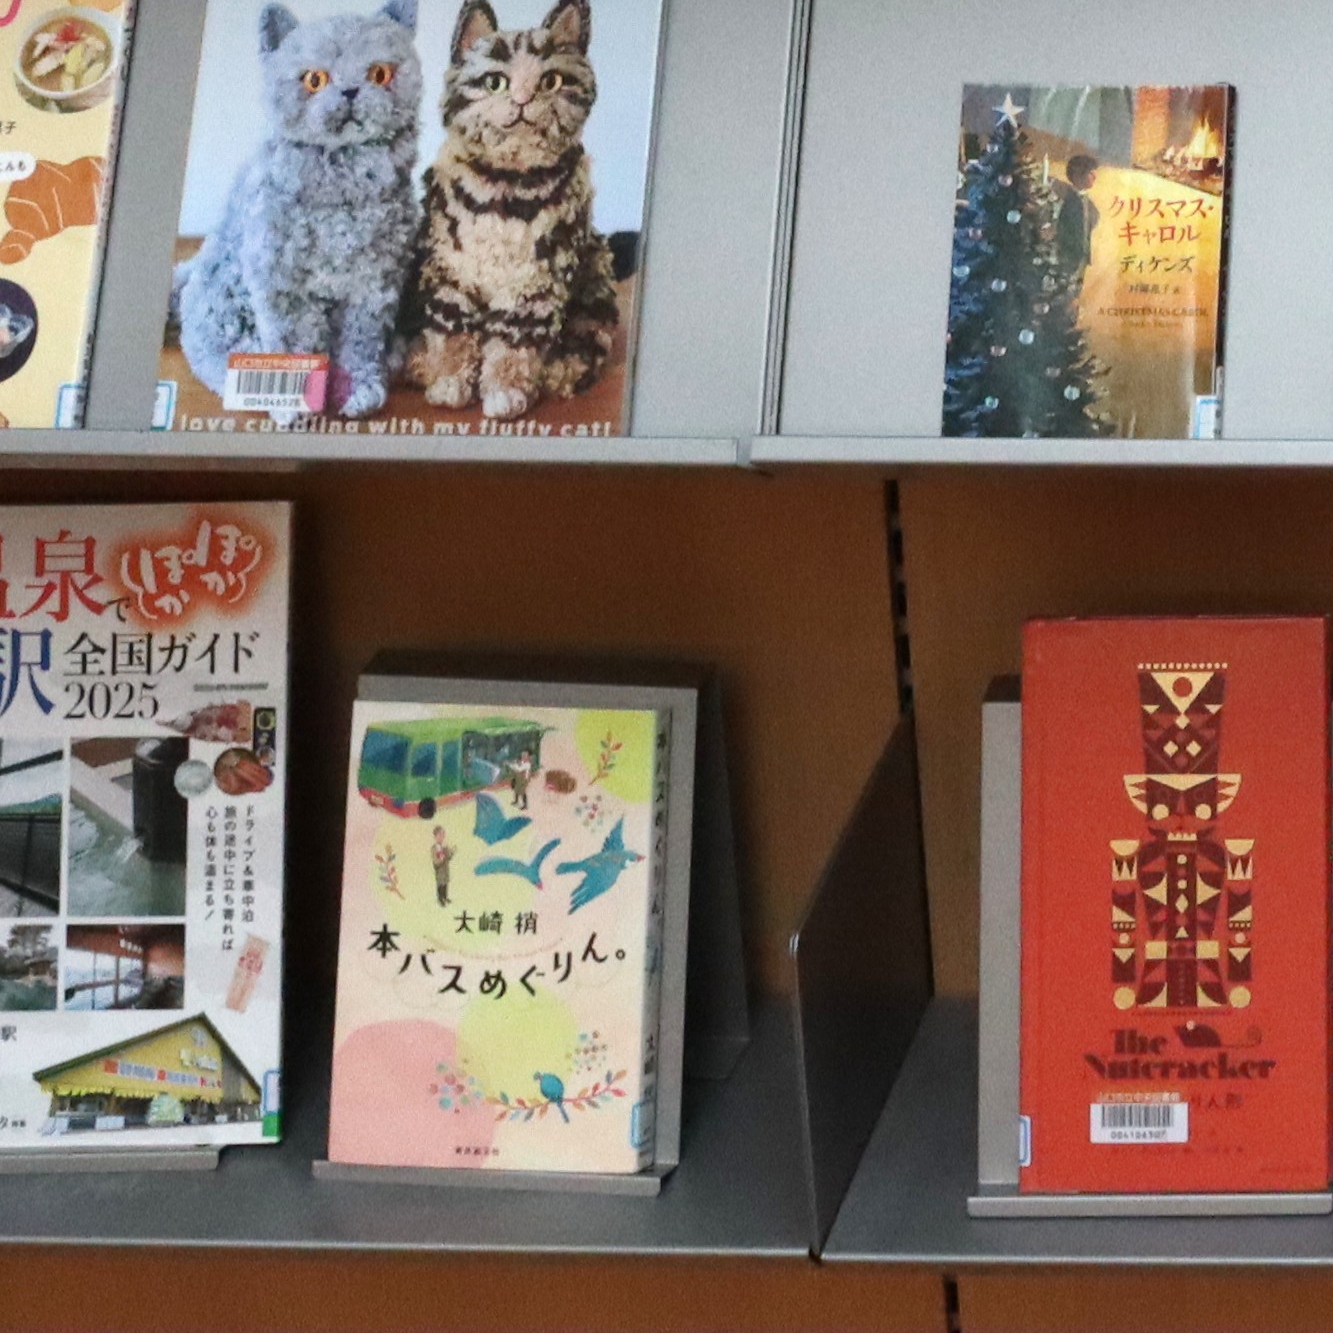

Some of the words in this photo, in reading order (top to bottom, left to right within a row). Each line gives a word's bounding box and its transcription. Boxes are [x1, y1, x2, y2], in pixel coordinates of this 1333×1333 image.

[1118, 221, 1202, 247] キャロル
[1120, 254, 1197, 274] ディケンズ
[181, 413, 237, 432] love
[369, 415, 426, 434] with
[63, 631, 260, 677] 全国ガイド
[63, 681, 159, 720] 2025
[454, 911, 504, 935] 大崎
[514, 911, 539, 935] 梢
[367, 923, 626, 1000] 本バスめぐりん。
